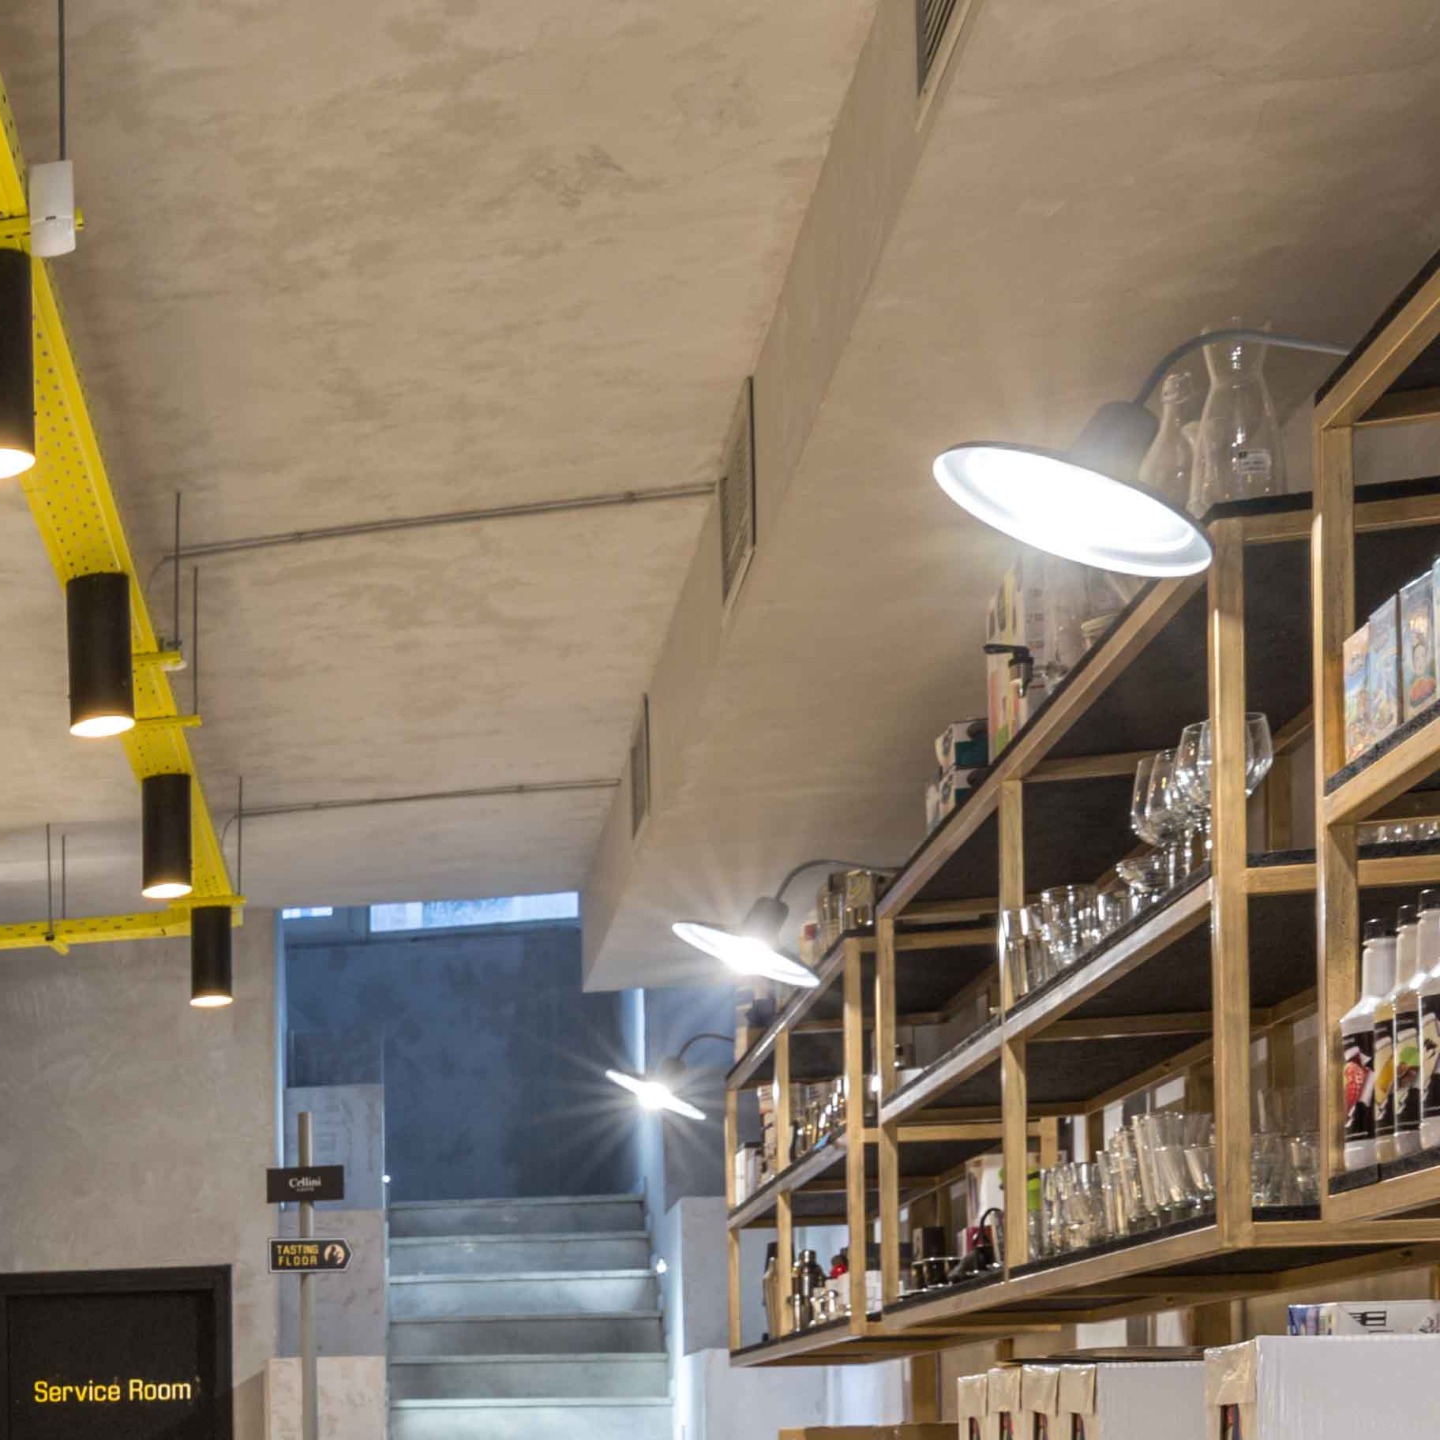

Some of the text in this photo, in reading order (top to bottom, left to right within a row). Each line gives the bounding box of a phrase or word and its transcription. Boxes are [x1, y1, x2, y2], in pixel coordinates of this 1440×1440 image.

[288, 1176, 322, 1189] Cellini
[276, 1244, 319, 1256] TASTING
[278, 1255, 318, 1266] FLOOR
[33, 1378, 192, 1403] Service Room
